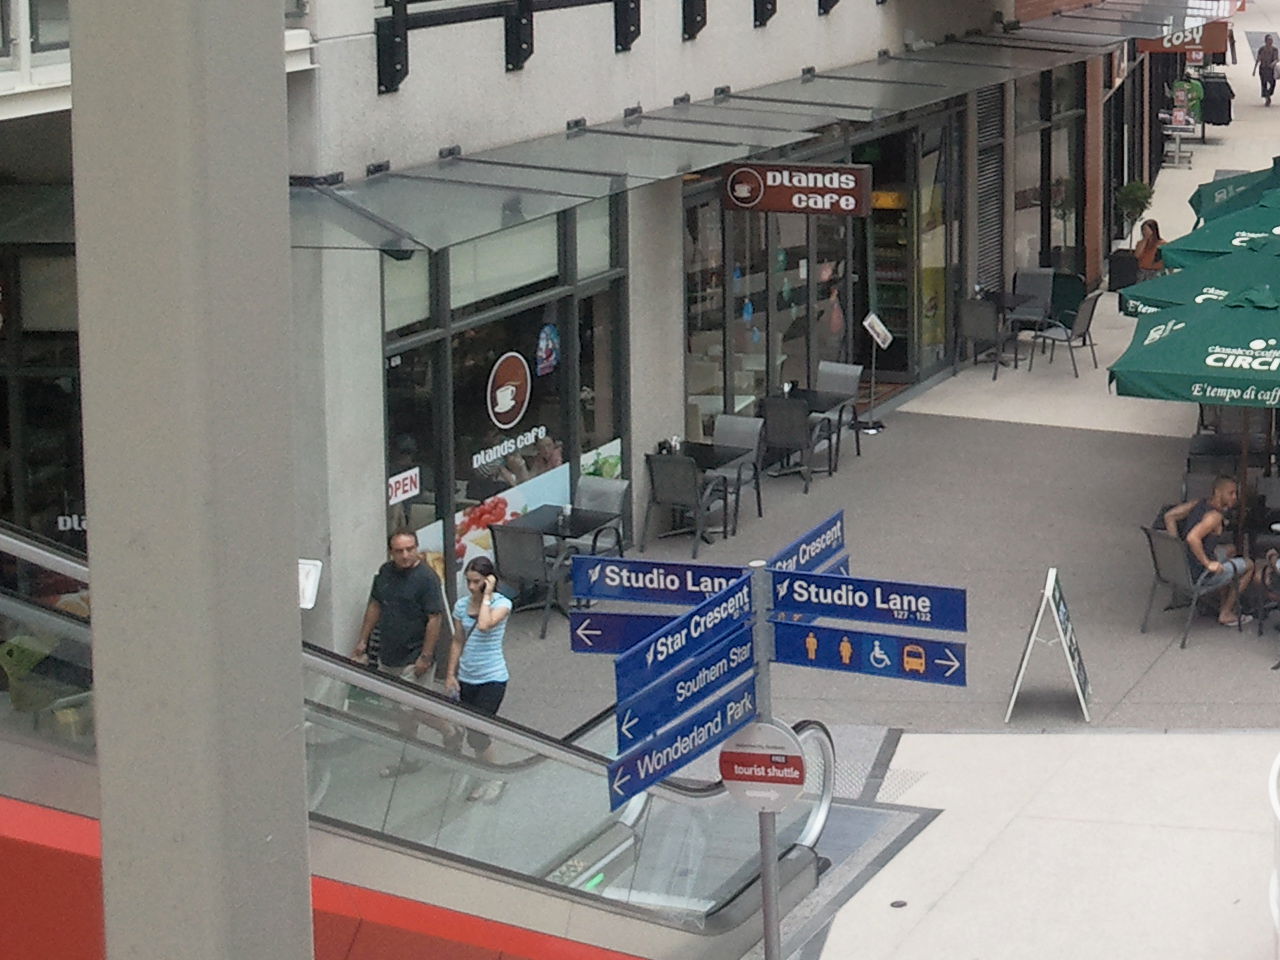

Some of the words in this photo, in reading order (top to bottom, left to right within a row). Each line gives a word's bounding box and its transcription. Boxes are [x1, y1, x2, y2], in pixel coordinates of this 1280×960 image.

[1243, 386, 1257, 399] di
[799, 520, 842, 565] Crescent
[605, 565, 680, 590] Studio
[792, 579, 869, 607] Studio
[875, 587, 931, 613] Lane
[655, 627, 688, 661] Star
[690, 584, 750, 638] Crescent
[893, 610, 908, 620] 127
[916, 611, 932, 622] 132
[676, 662, 728, 702] Southern
[729, 642, 752, 668] Star
[637, 711, 722, 780] Wonderland
[726, 692, 753, 725] Park
[734, 764, 766, 776] tourist
[767, 765, 800, 779] shuttle
